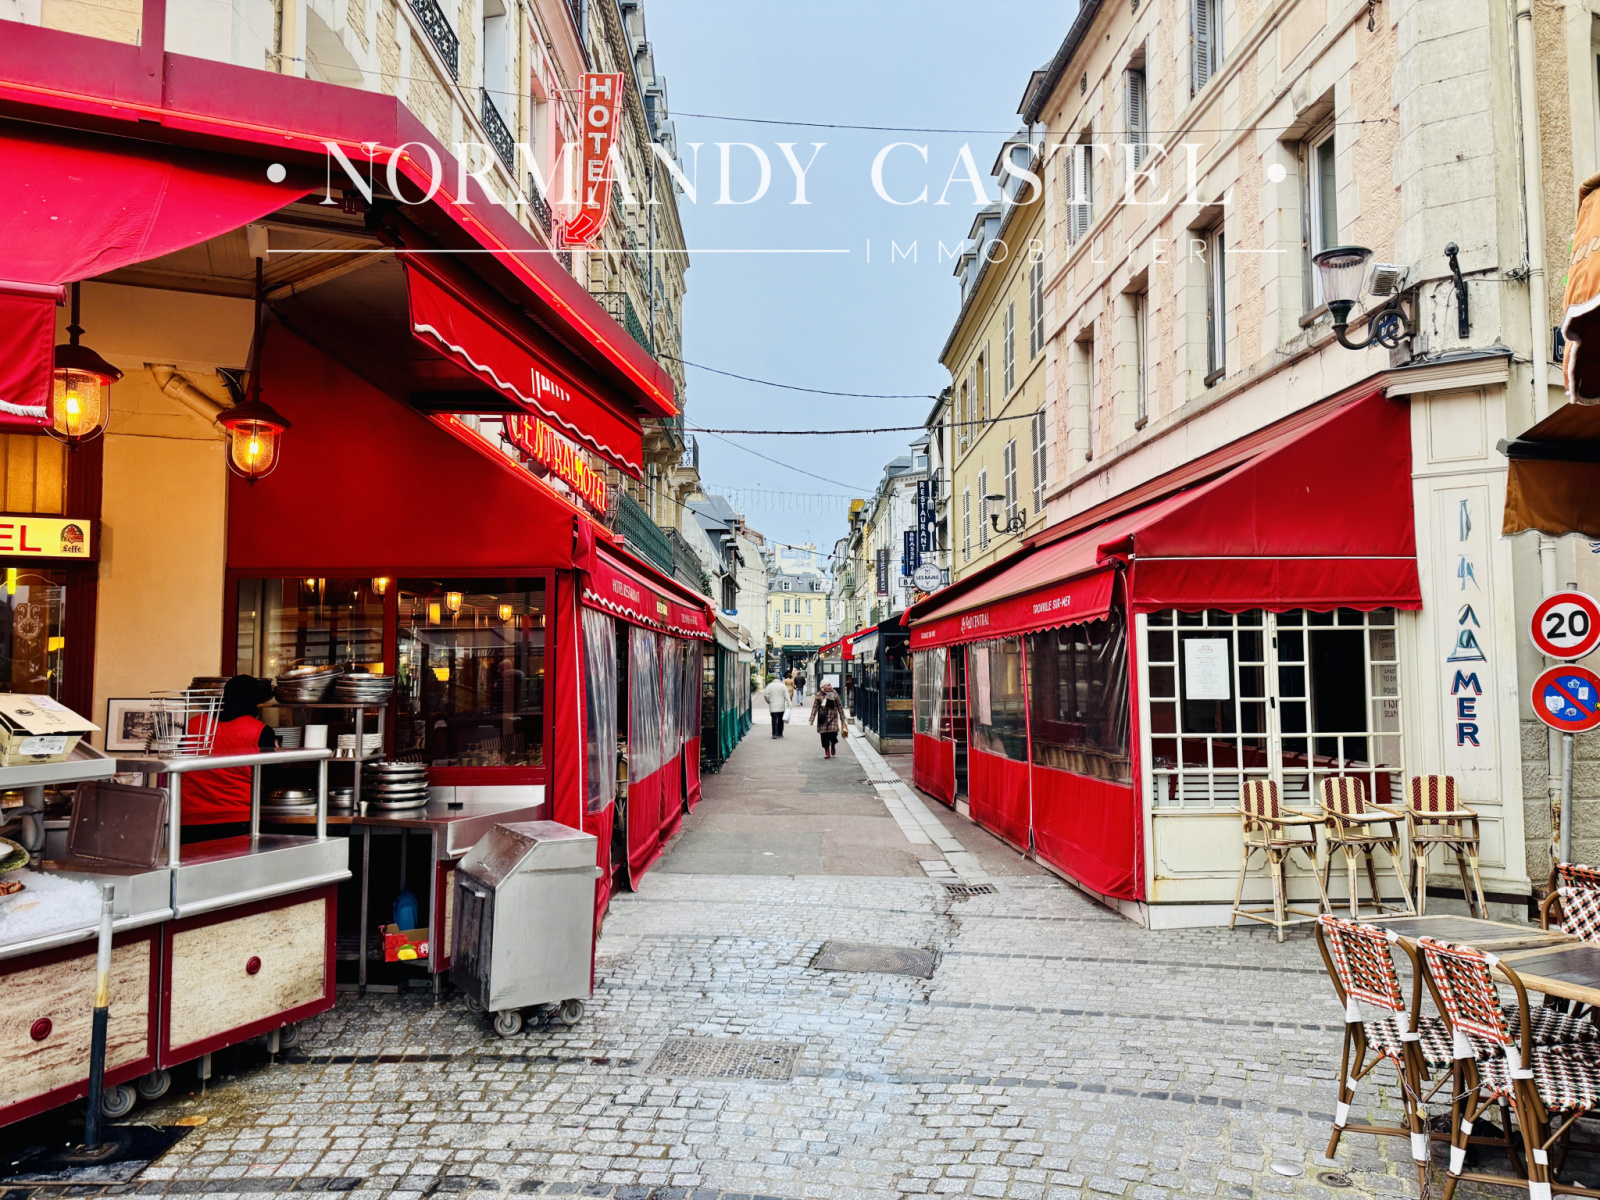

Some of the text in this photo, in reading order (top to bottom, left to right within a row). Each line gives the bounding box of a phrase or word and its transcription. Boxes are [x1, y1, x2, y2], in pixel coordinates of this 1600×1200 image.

[588, 78, 612, 210] HOTEL
[574, 455, 607, 513] HOTEL
[919, 481, 927, 551] RESTAURANT
[62, 545, 82, 553] Leffe
[1545, 610, 1589, 639] 20
[1451, 668, 1483, 747] MER
